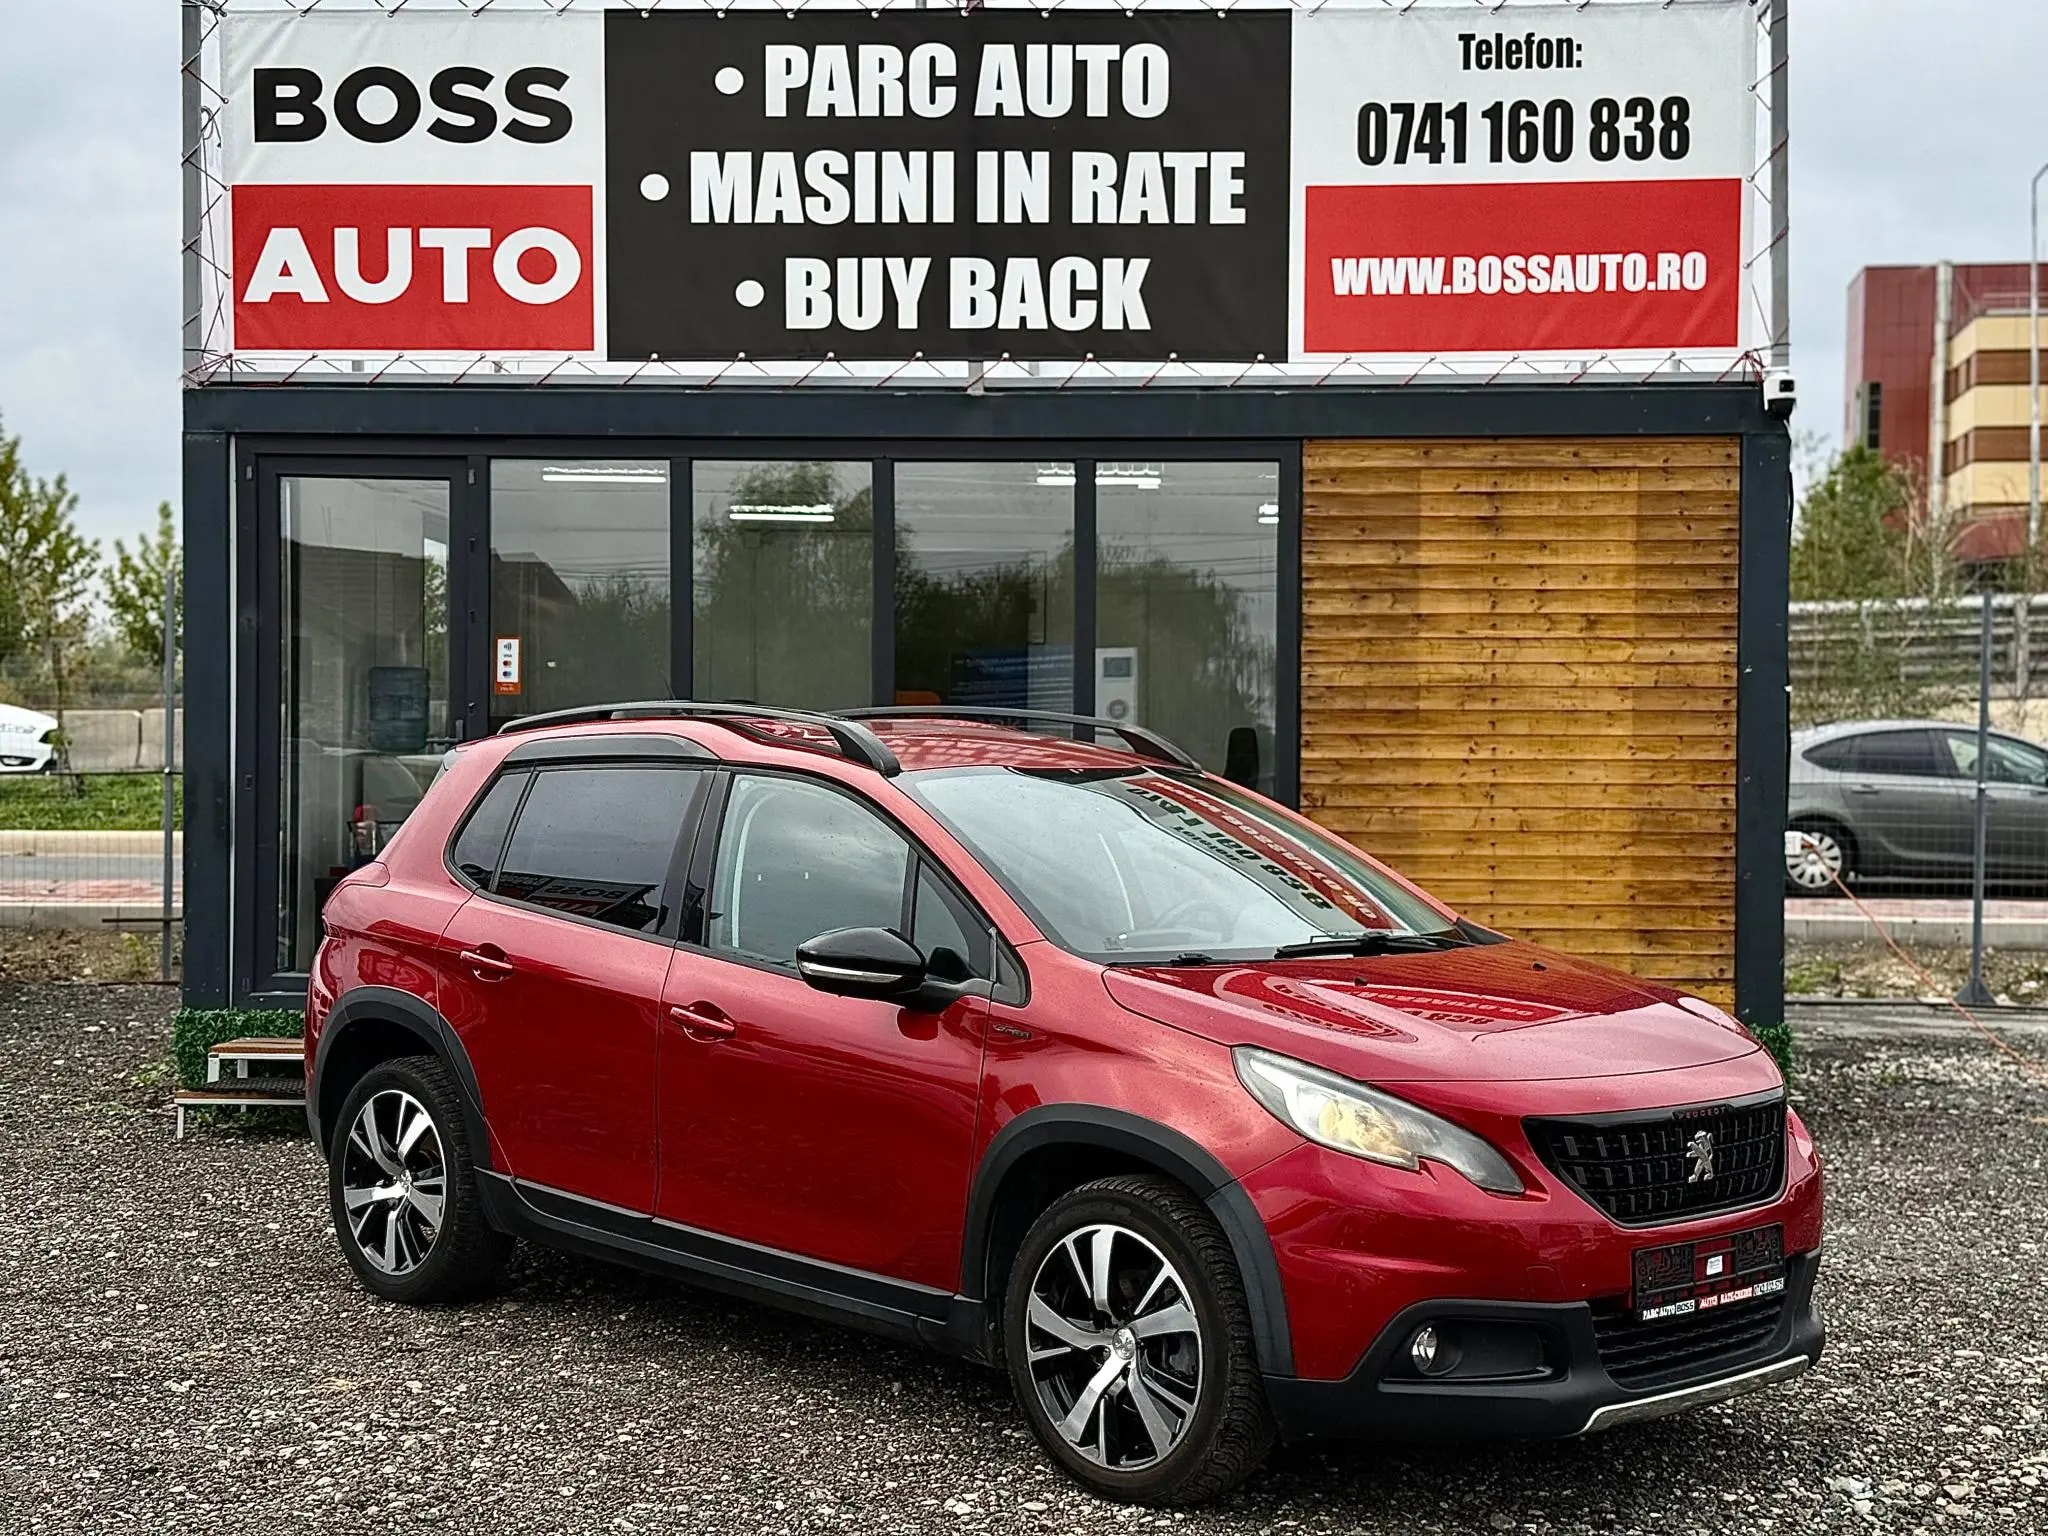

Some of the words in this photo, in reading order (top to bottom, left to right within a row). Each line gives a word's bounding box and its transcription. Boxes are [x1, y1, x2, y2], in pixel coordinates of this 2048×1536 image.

[765, 43, 957, 118] PARC
[973, 43, 1170, 118] AUTO
[1458, 33, 1583, 70] Telefon:
[253, 66, 573, 144] BOSS
[1356, 101, 1467, 166] 0741
[1481, 99, 1574, 163] 160
[1589, 96, 1690, 162] 838
[690, 150, 955, 224] MASINI
[976, 151, 1050, 223] IN
[1071, 151, 1247, 224] RATE
[242, 227, 582, 305] AUTO
[785, 257, 932, 331] BUY
[949, 256, 1151, 331] BACK
[1331, 251, 1708, 296] WWW.BOSSAUTO.RO
[1676, 1301, 1694, 1313] BOSS
